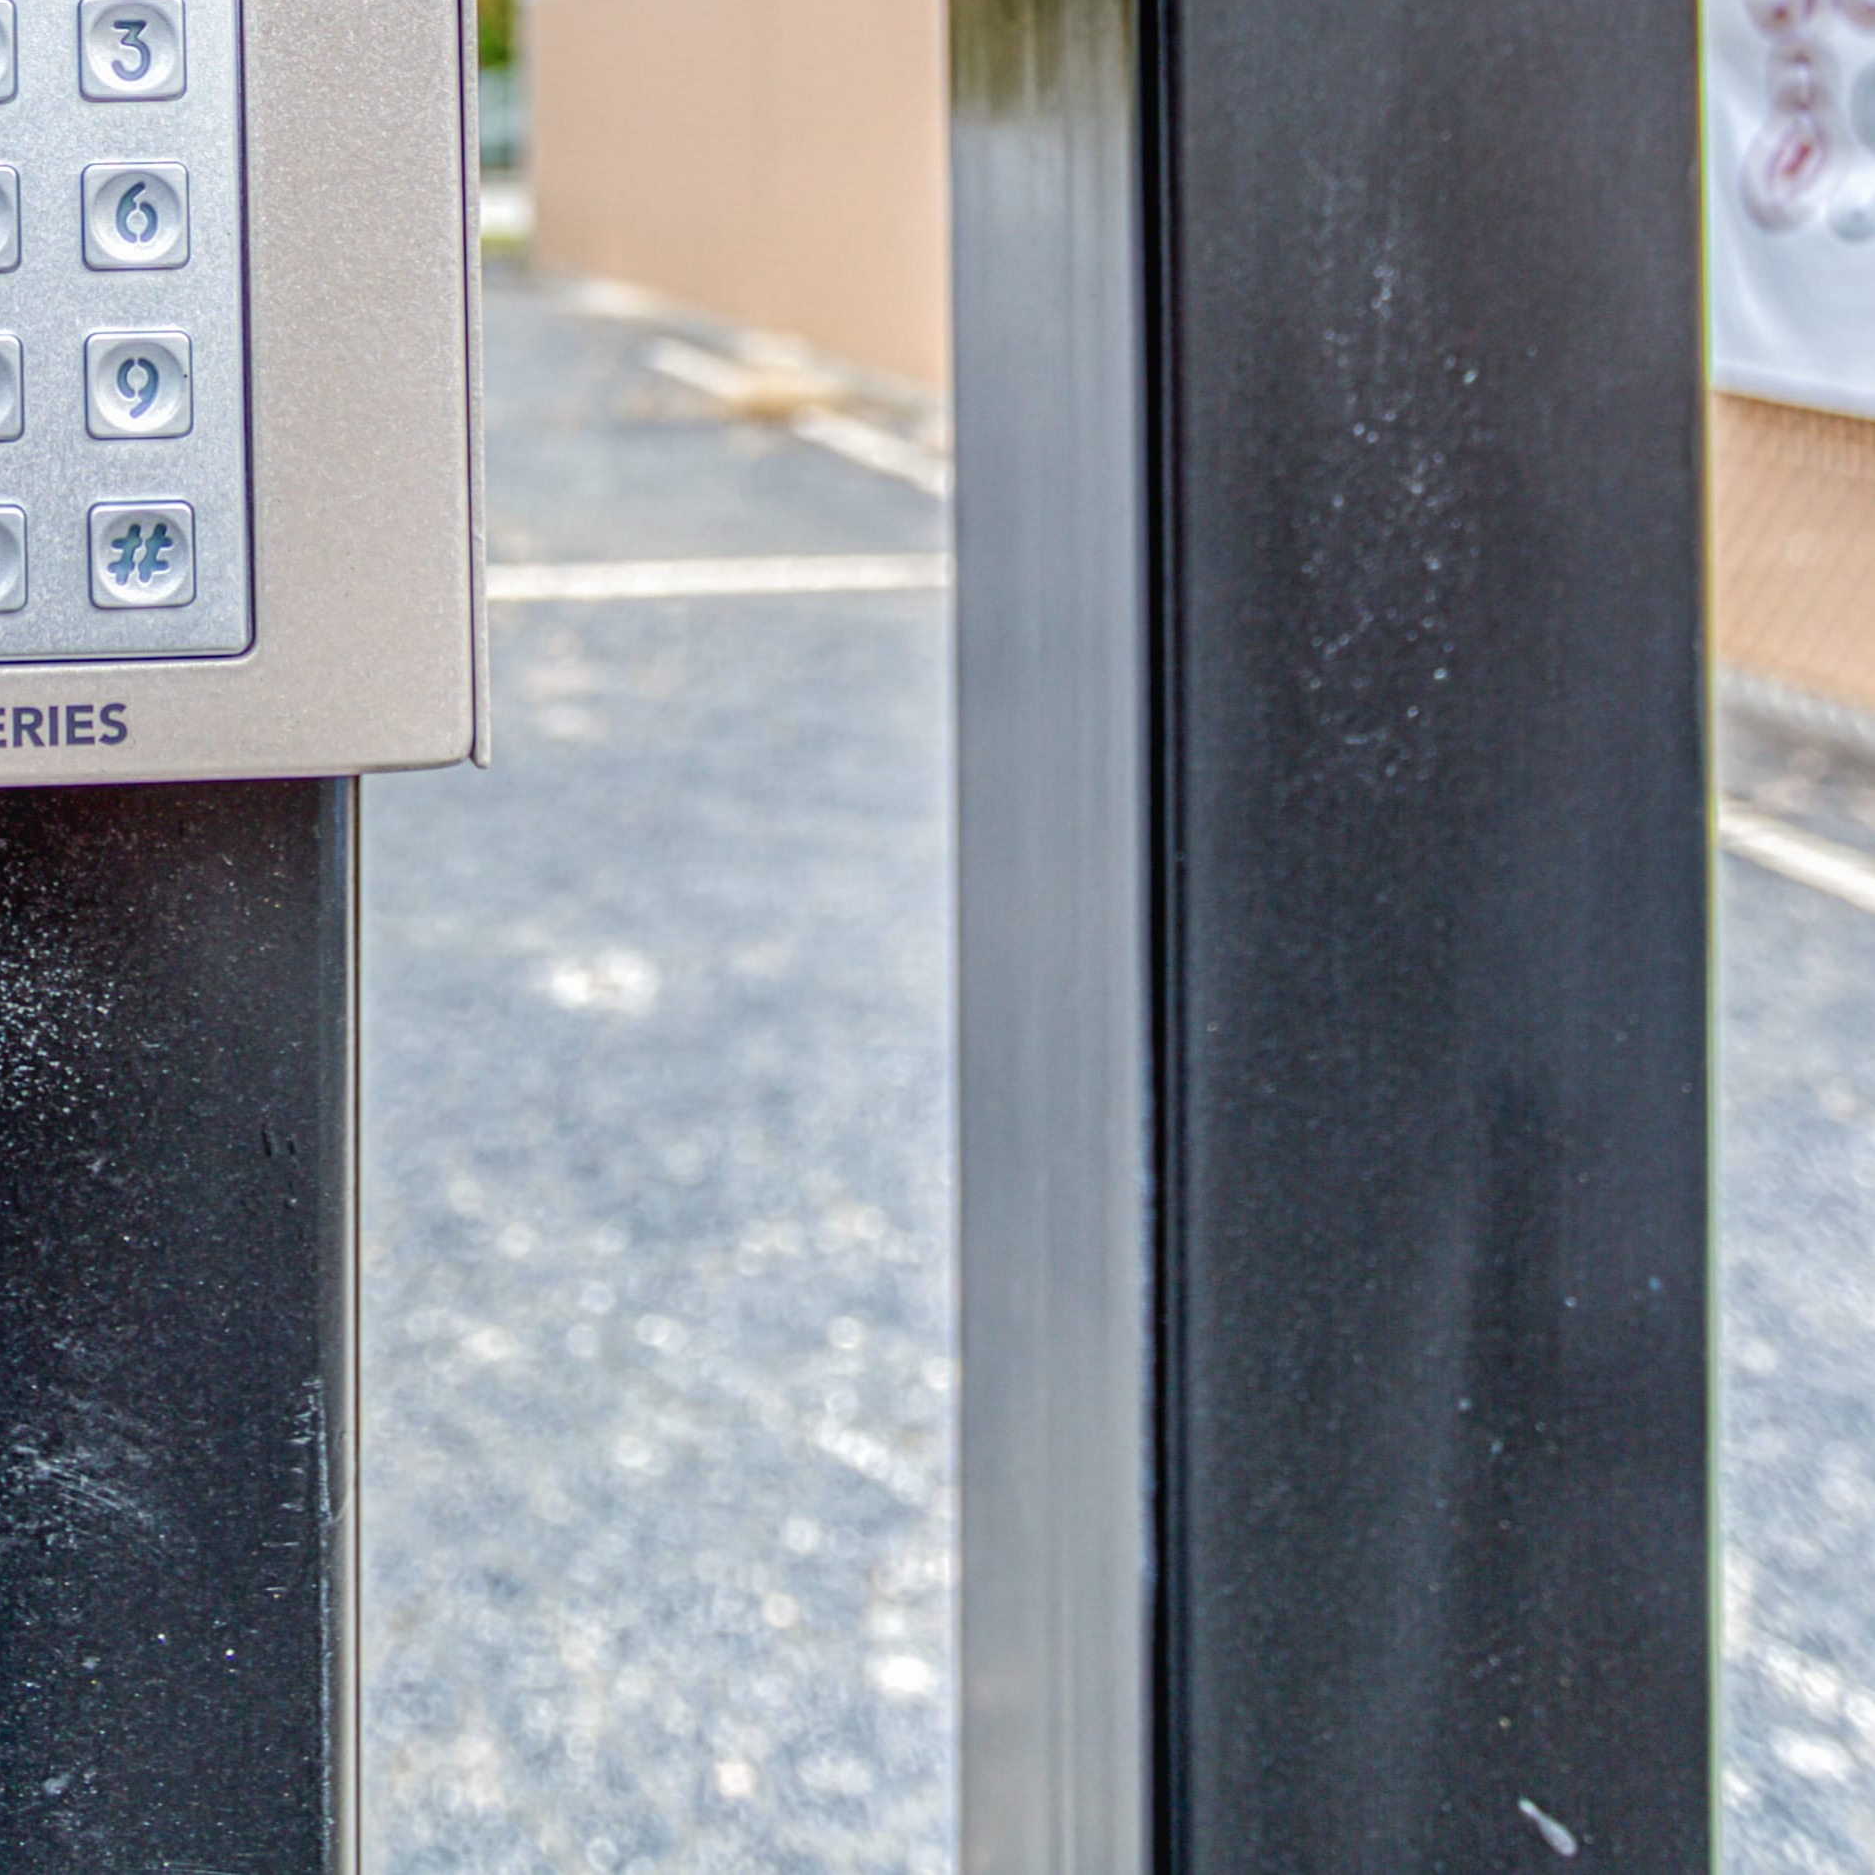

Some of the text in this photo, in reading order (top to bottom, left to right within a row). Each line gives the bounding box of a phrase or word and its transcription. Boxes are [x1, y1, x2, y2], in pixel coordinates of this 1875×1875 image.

[110, 20, 151, 81] 3
[115, 182, 159, 244] 6
[115, 357, 160, 418] 9
